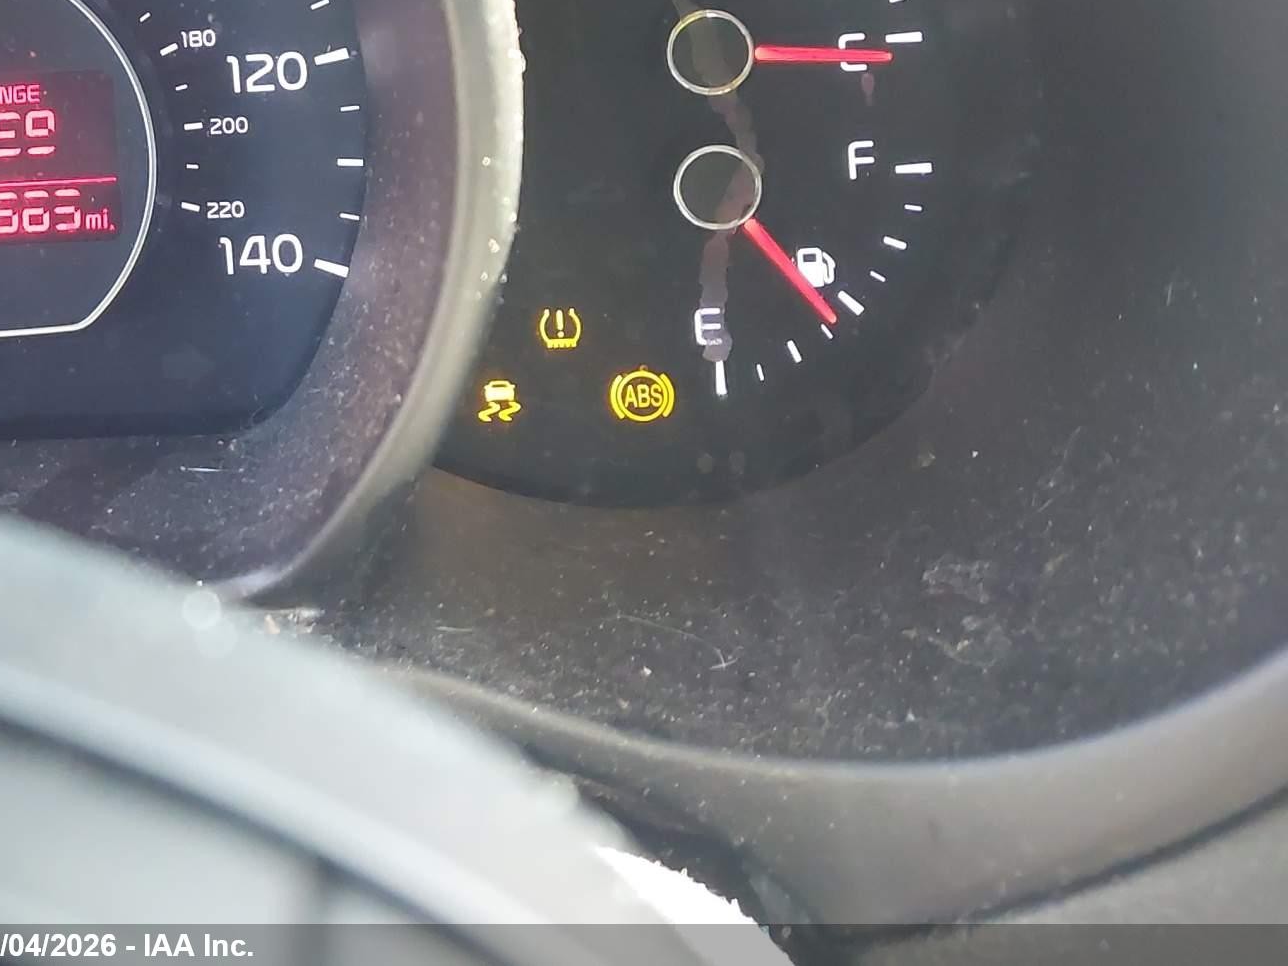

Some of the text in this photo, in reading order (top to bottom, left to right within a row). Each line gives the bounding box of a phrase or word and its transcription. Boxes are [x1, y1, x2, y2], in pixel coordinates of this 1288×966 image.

[180, 28, 216, 48] 180
[226, 51, 308, 94] 120
[210, 116, 249, 135] 200
[847, 140, 875, 180] F
[85, 206, 116, 231] mi.
[206, 200, 245, 219] 220
[219, 233, 303, 275] 140
[693, 306, 724, 348] E
[624, 383, 663, 409] ABS
